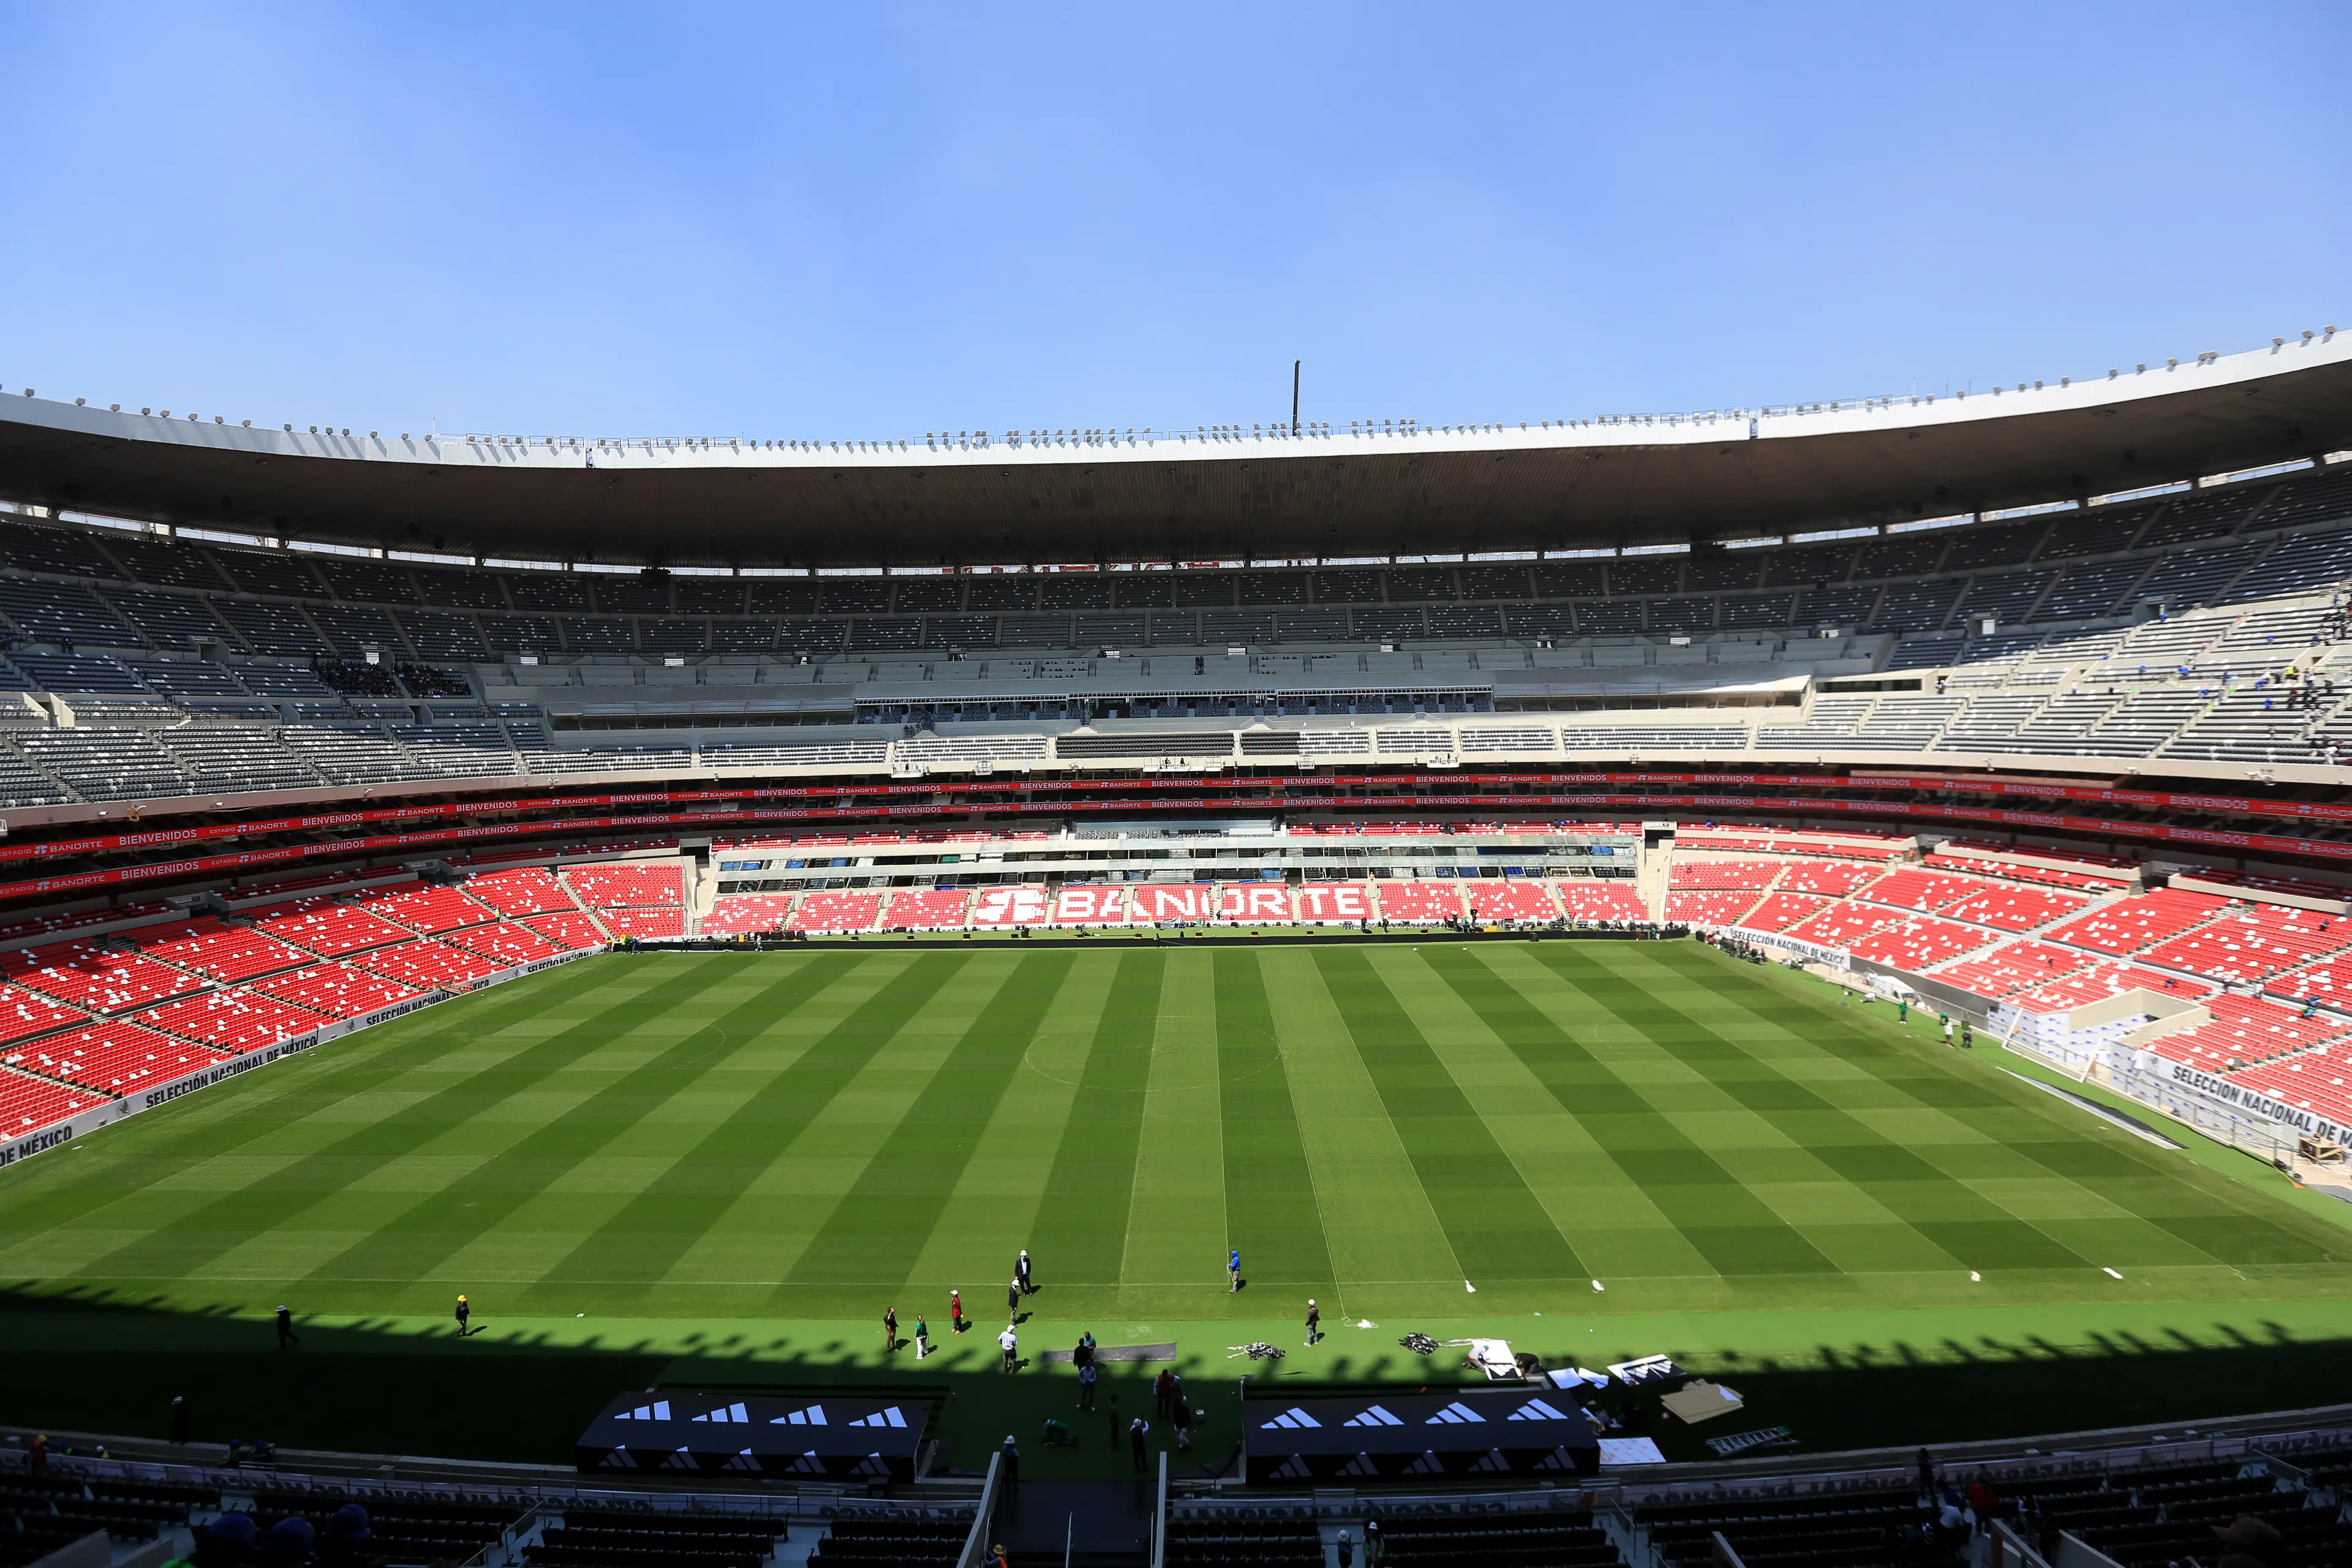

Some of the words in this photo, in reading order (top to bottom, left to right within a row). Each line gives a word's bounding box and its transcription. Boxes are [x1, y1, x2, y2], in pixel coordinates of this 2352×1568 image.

[2004, 785, 2065, 796] BIENVENIDOS
[2113, 793, 2155, 802] BANORTE
[2170, 796, 2249, 810] BIENVENIDOS
[457, 801, 518, 812] BIENVENIDOS
[1849, 802, 1909, 812] BIENVENIDOS
[303, 813, 363, 826] BIENVENIDOS
[611, 816, 669, 824] BIENVENIDOS
[2003, 812, 2065, 825] BIENVENIDOS
[249, 822, 288, 831] BANORTE
[458, 826, 518, 836] BIENVENIDOS
[2112, 824, 2155, 834] BANORTE
[119, 829, 197, 845] BIENVENIDOS
[2169, 828, 2249, 845] BIENVENIDOS
[50, 841, 102, 851] BANORTE
[304, 840, 364, 854] BIENVENIDOS
[251, 851, 290, 861] BANORTE
[122, 862, 198, 879] BIENVENIDOS
[53, 875, 105, 888] BANORTE
[1058, 888, 1366, 919] BANORTE
[1777, 938, 1808, 955] NACIONAL
[1811, 948, 1820, 959] DE
[366, 1004, 411, 1026] SELECCIÓN
[146, 1073, 208, 1108] SELECCIÓN
[211, 1055, 265, 1083] NACIONAL
[267, 1049, 279, 1063] DE
[282, 1036, 317, 1055] MÉXICO
[2242, 1092, 2312, 1133] NACIONAL
[2316, 1121, 2337, 1140] DE
[19, 1126, 72, 1159] MÉXICO
